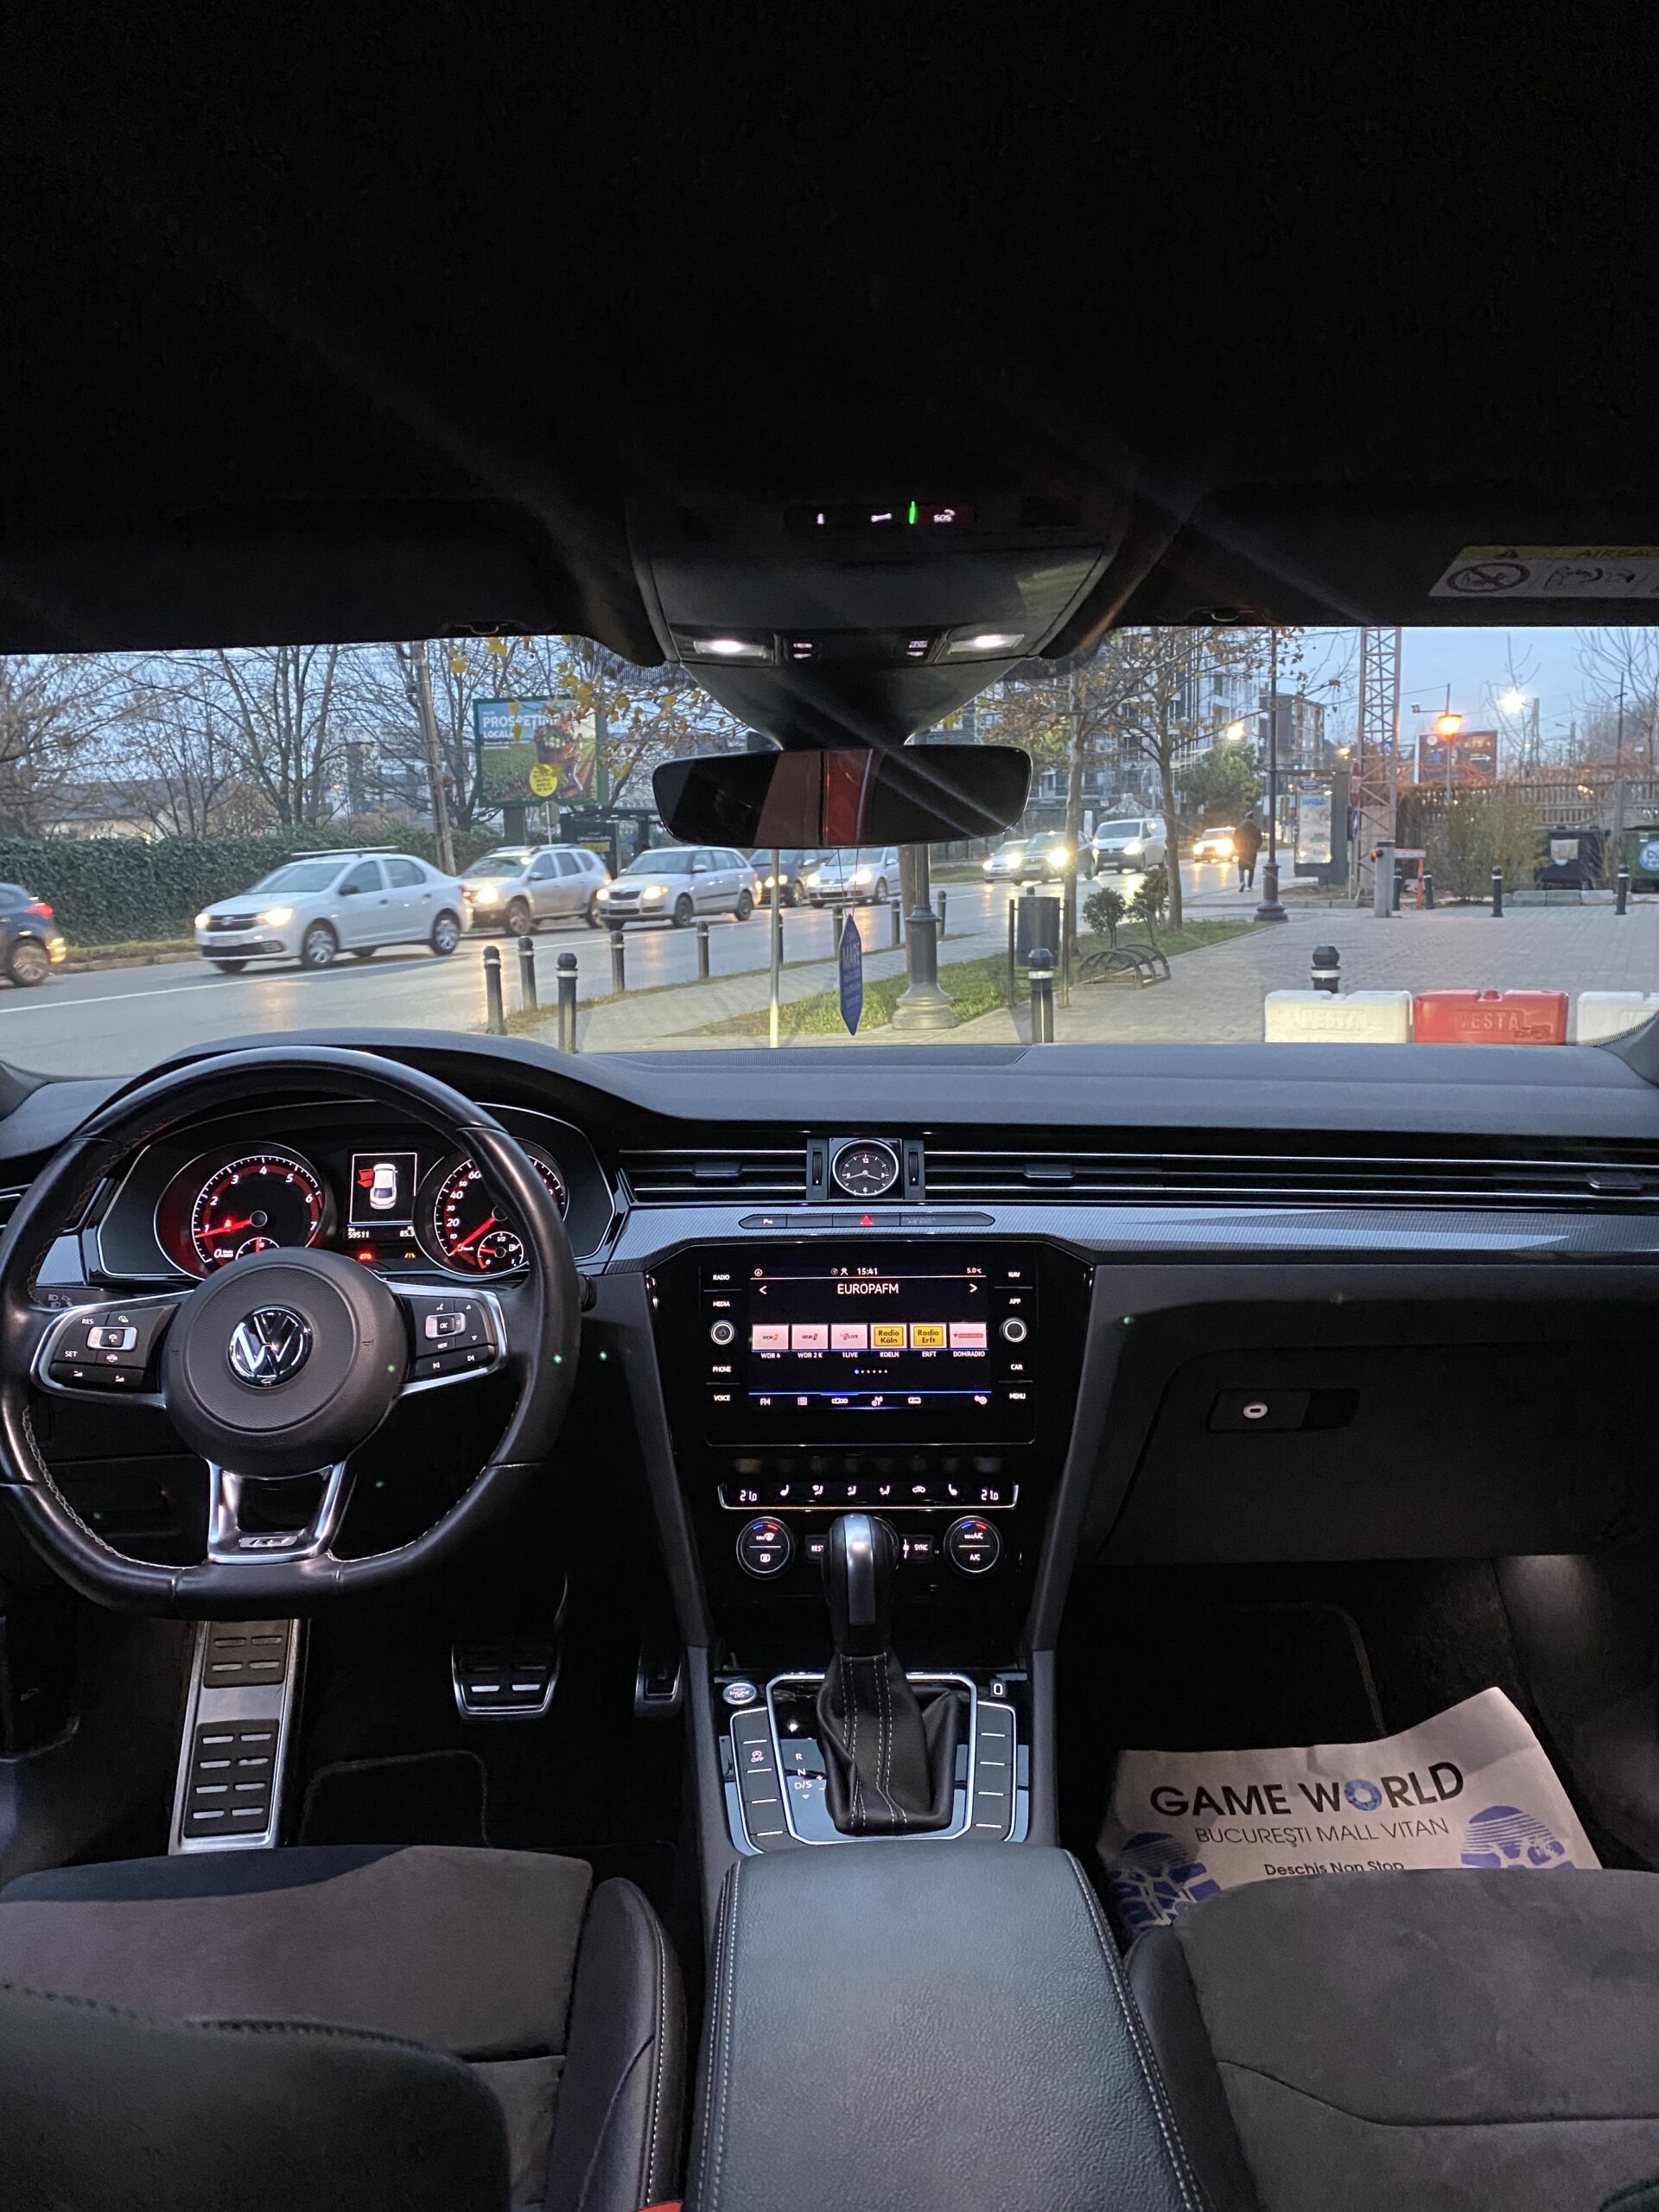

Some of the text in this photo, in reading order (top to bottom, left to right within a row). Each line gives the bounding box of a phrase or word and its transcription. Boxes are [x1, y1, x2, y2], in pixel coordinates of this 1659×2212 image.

[933, 514, 952, 523] SOS
[259, 1166, 268, 1175] 4
[467, 1170, 481, 1179] 60
[231, 1175, 239, 1185] 3
[285, 1173, 294, 1183] 5
[305, 1193, 314, 1203] 6
[449, 1191, 463, 1199] 40
[209, 1196, 219, 1206] 2
[309, 1221, 318, 1231] 7
[446, 1217, 460, 1227] 20
[204, 1224, 210, 1233] 1
[347, 1230, 370, 1239] 59511
[213, 1249, 222, 1258] 0
[856, 1267, 878, 1275] 15:41
[836, 1282, 899, 1294] EUROPAFM
[797, 1768, 806, 1777] N
[794, 1781, 812, 1789] D/S
[1150, 1762, 1464, 1816] GAME WORLD
[1316, 1824, 1379, 1842] MALL
[1381, 1817, 1449, 1839] VITAN
[1264, 1863, 1326, 1875] Deschis
[1331, 1862, 1364, 1872] Non
